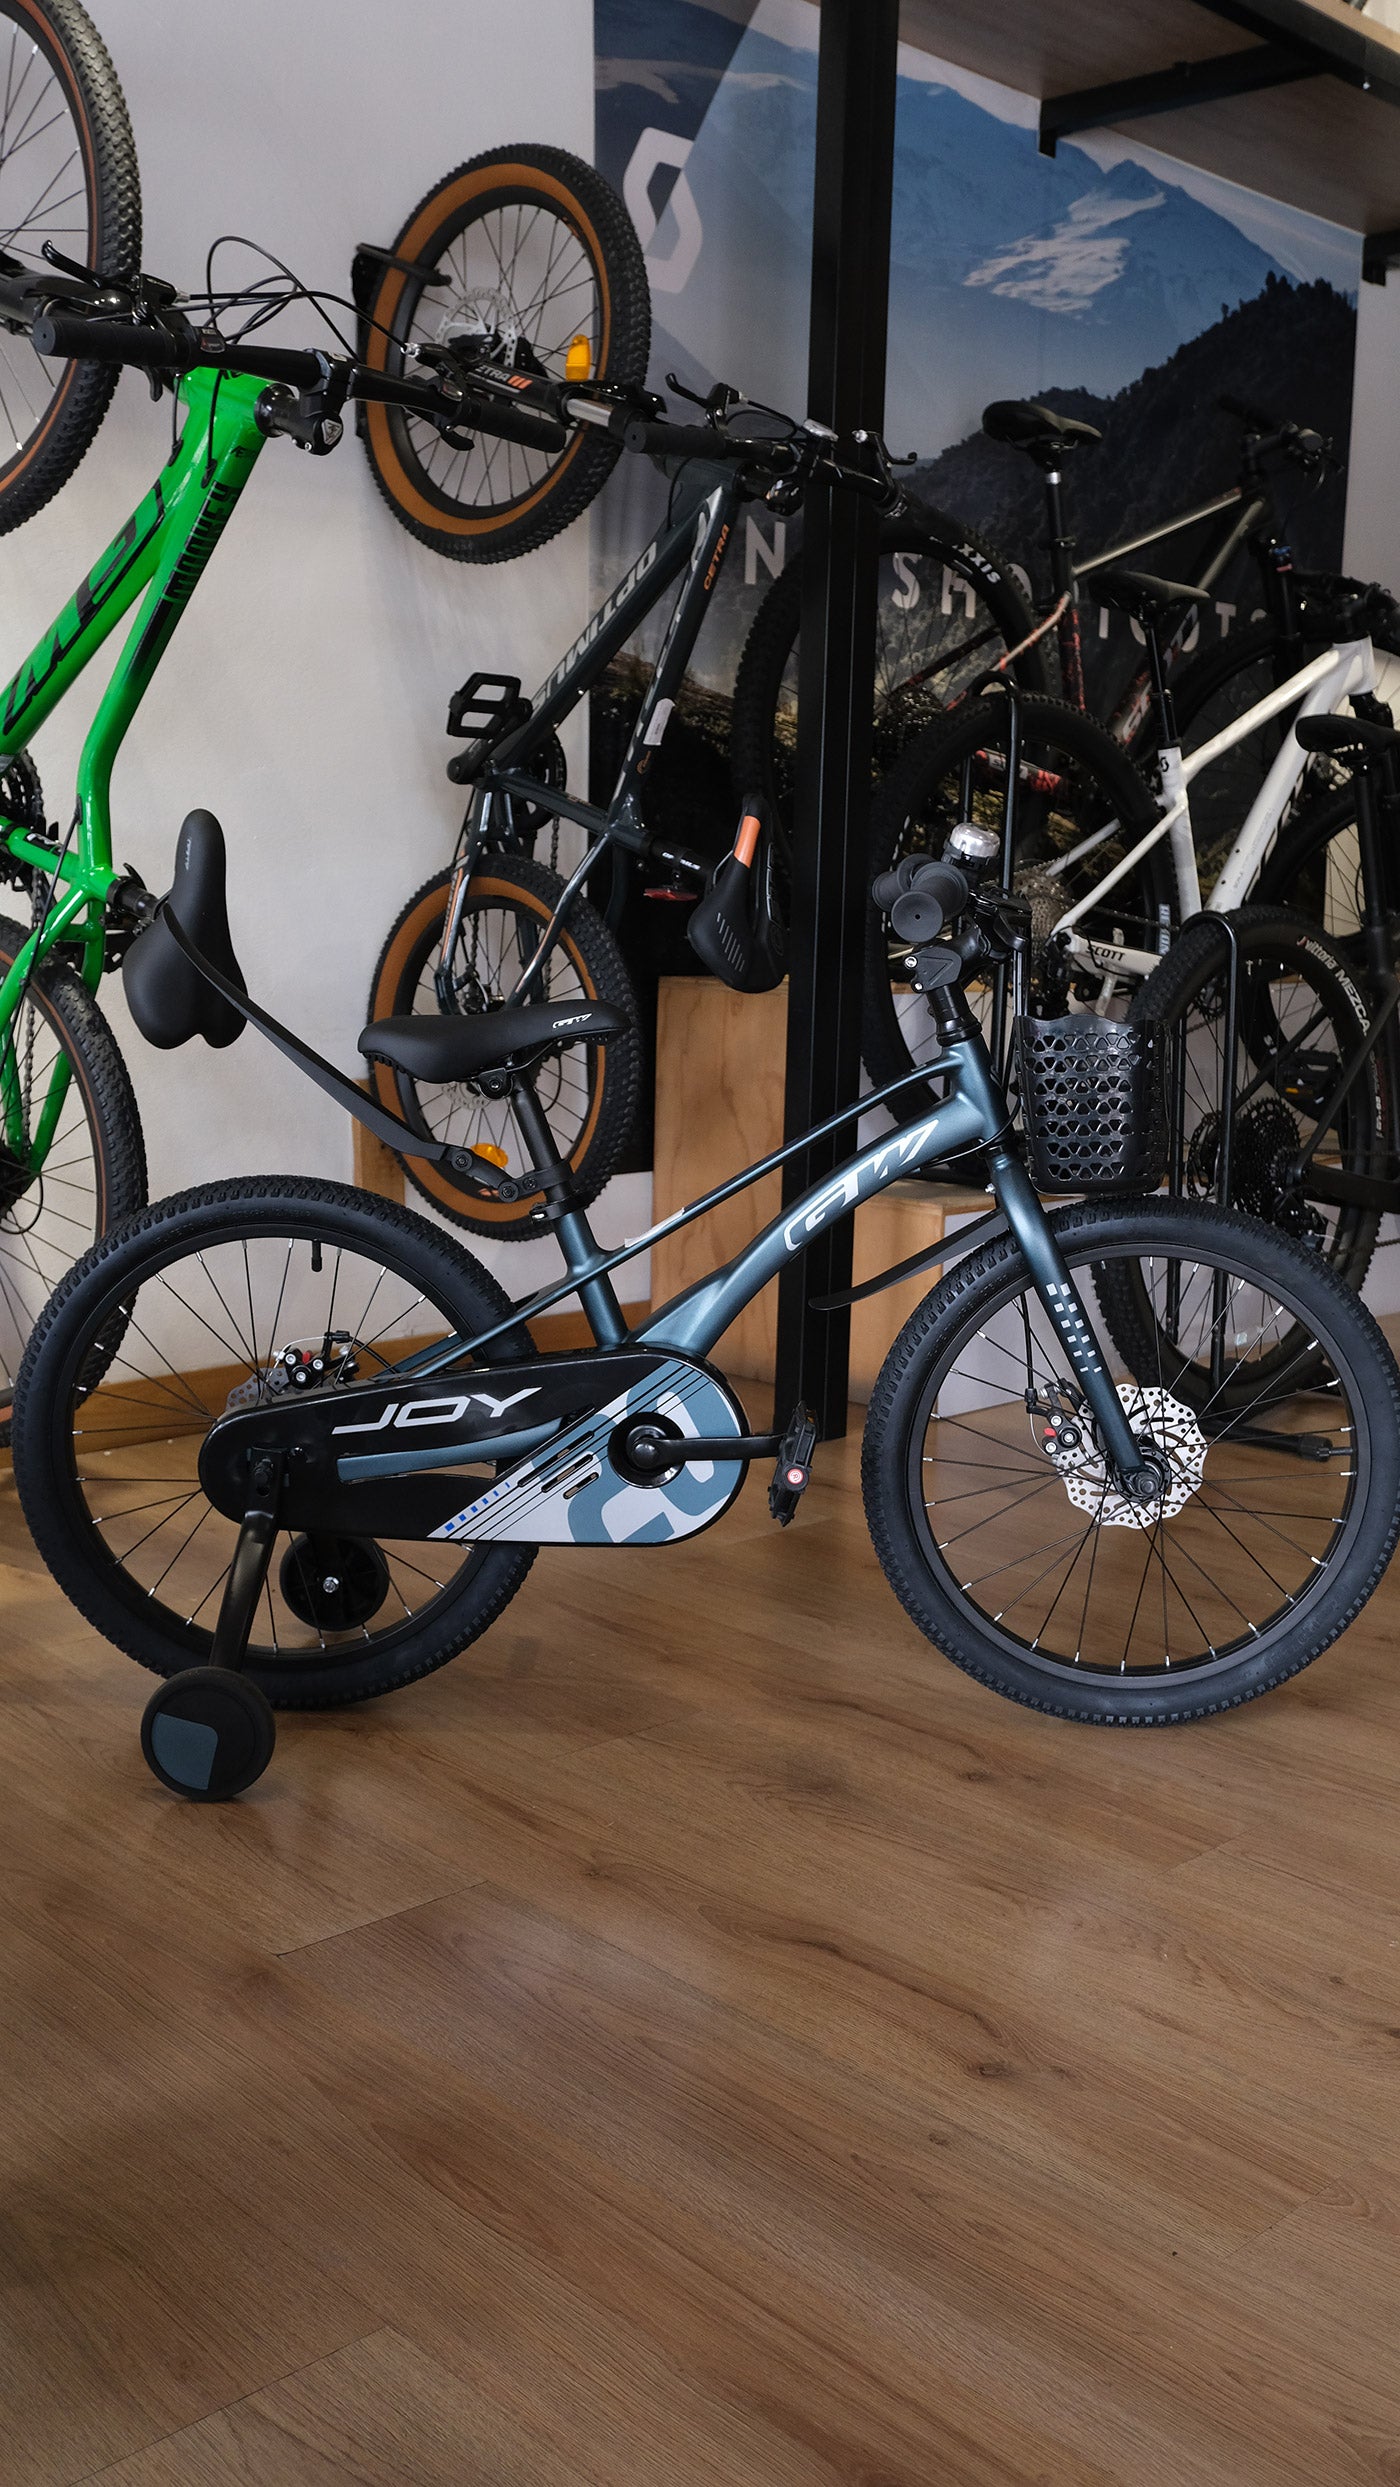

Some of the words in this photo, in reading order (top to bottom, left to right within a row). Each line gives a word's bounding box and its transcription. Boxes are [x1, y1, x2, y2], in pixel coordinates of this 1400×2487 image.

[703, 522, 732, 591] CETRA
[530, 541, 658, 717] OPTIMUS
[1085, 943, 1126, 963] SCOTT
[1304, 938, 1338, 970] vittoria
[1334, 968, 1373, 1036] MEZCA
[331, 1386, 543, 1436] JOY
